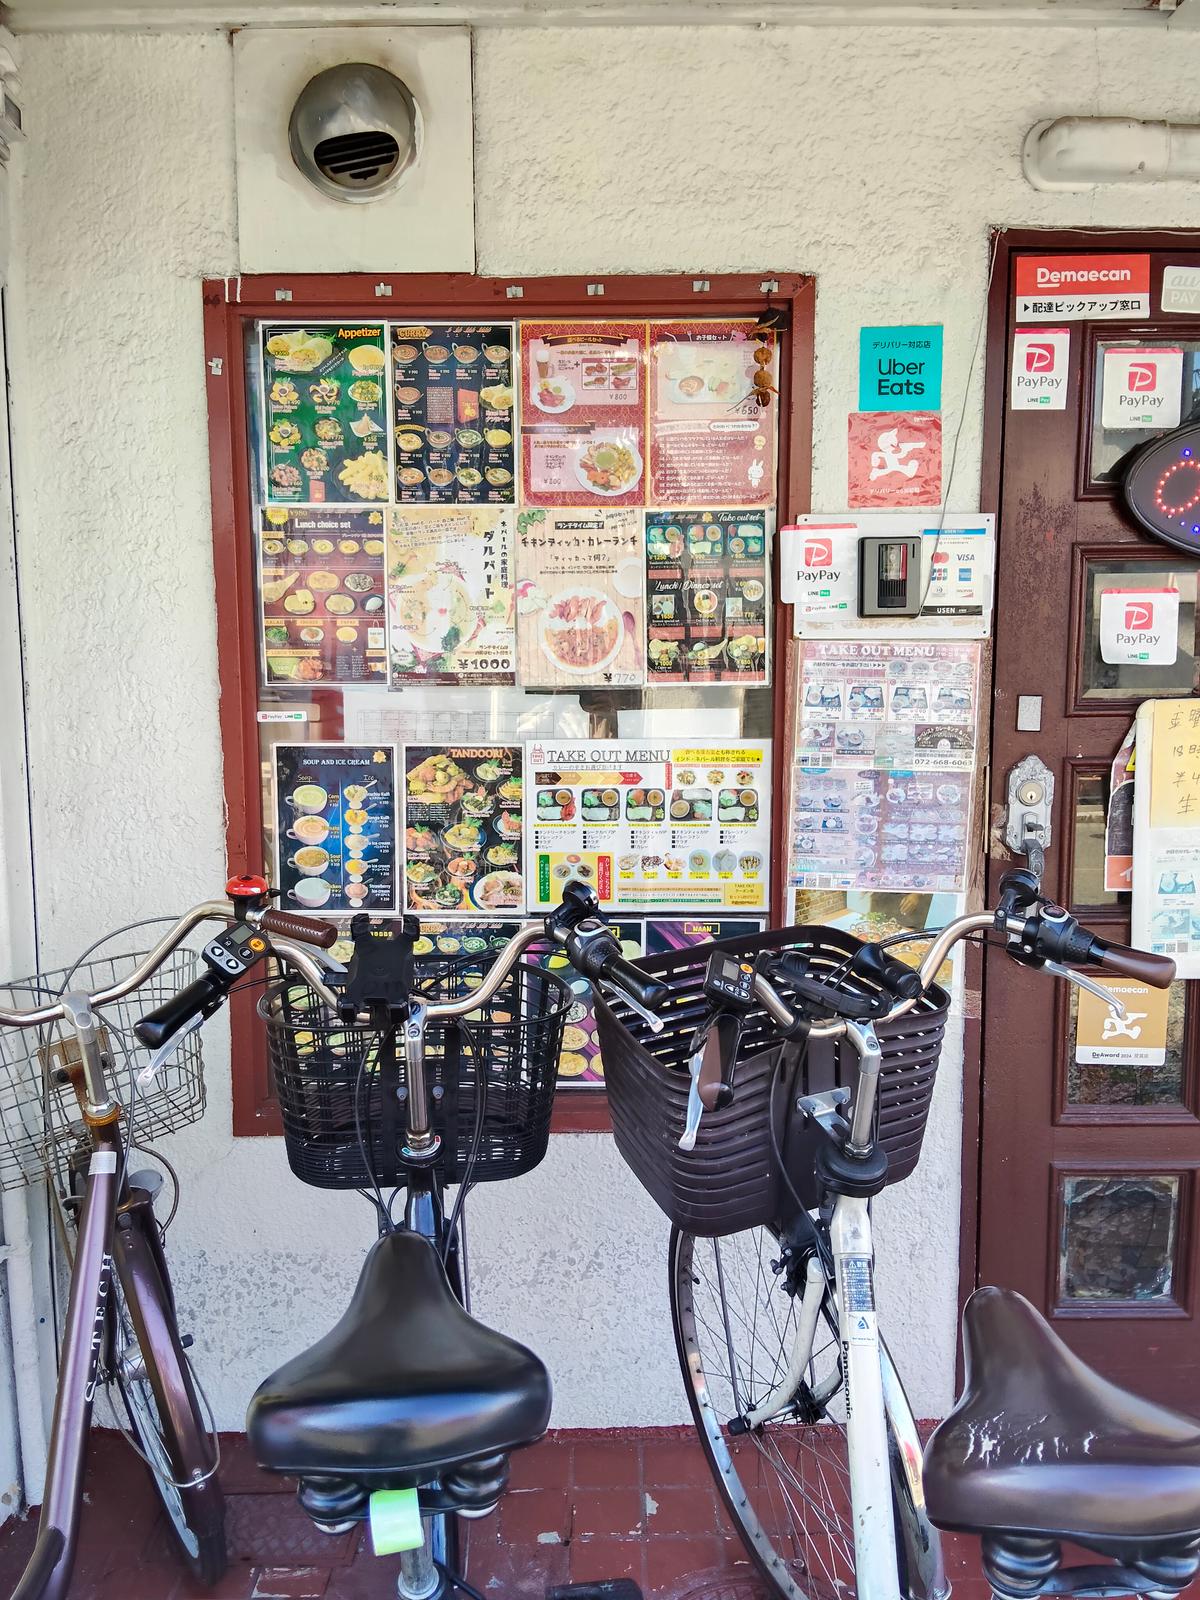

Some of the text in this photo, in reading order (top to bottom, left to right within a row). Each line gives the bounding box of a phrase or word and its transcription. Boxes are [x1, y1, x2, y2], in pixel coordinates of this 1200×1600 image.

[1036, 267, 1131, 283] Demaecan
[1032, 300, 1141, 313] 配達ピックアップ窓口
[337, 327, 381, 339] Appetizer
[872, 341, 932, 349] デリバリー対応店
[878, 358, 926, 376] Uber
[877, 379, 925, 396] Eats
[1017, 375, 1062, 390] PayPay
[1119, 394, 1165, 408] PayPay
[717, 512, 736, 522] Take
[294, 518, 352, 529] Lunch choice set
[521, 535, 638, 547] チキンティッカ・カレーランチ
[500, 520, 509, 588] ネパールの家庭料理
[482, 530, 496, 599] ダルバート
[797, 570, 841, 582] PayPay
[655, 580, 679, 592] Lunch
[1116, 633, 1161, 646] PayPay
[819, 645, 936, 657] TAKE OUT MENU
[457, 658, 511, 670] ¥1000
[450, 749, 504, 759] TANDOORI
[547, 750, 671, 762] TAKE OUT MENU
[914, 758, 973, 766] 072-668-6063
[691, 924, 712, 933] NAAN
[1106, 985, 1149, 994] emaecan
[842, 1340, 853, 1420] Panasonic
